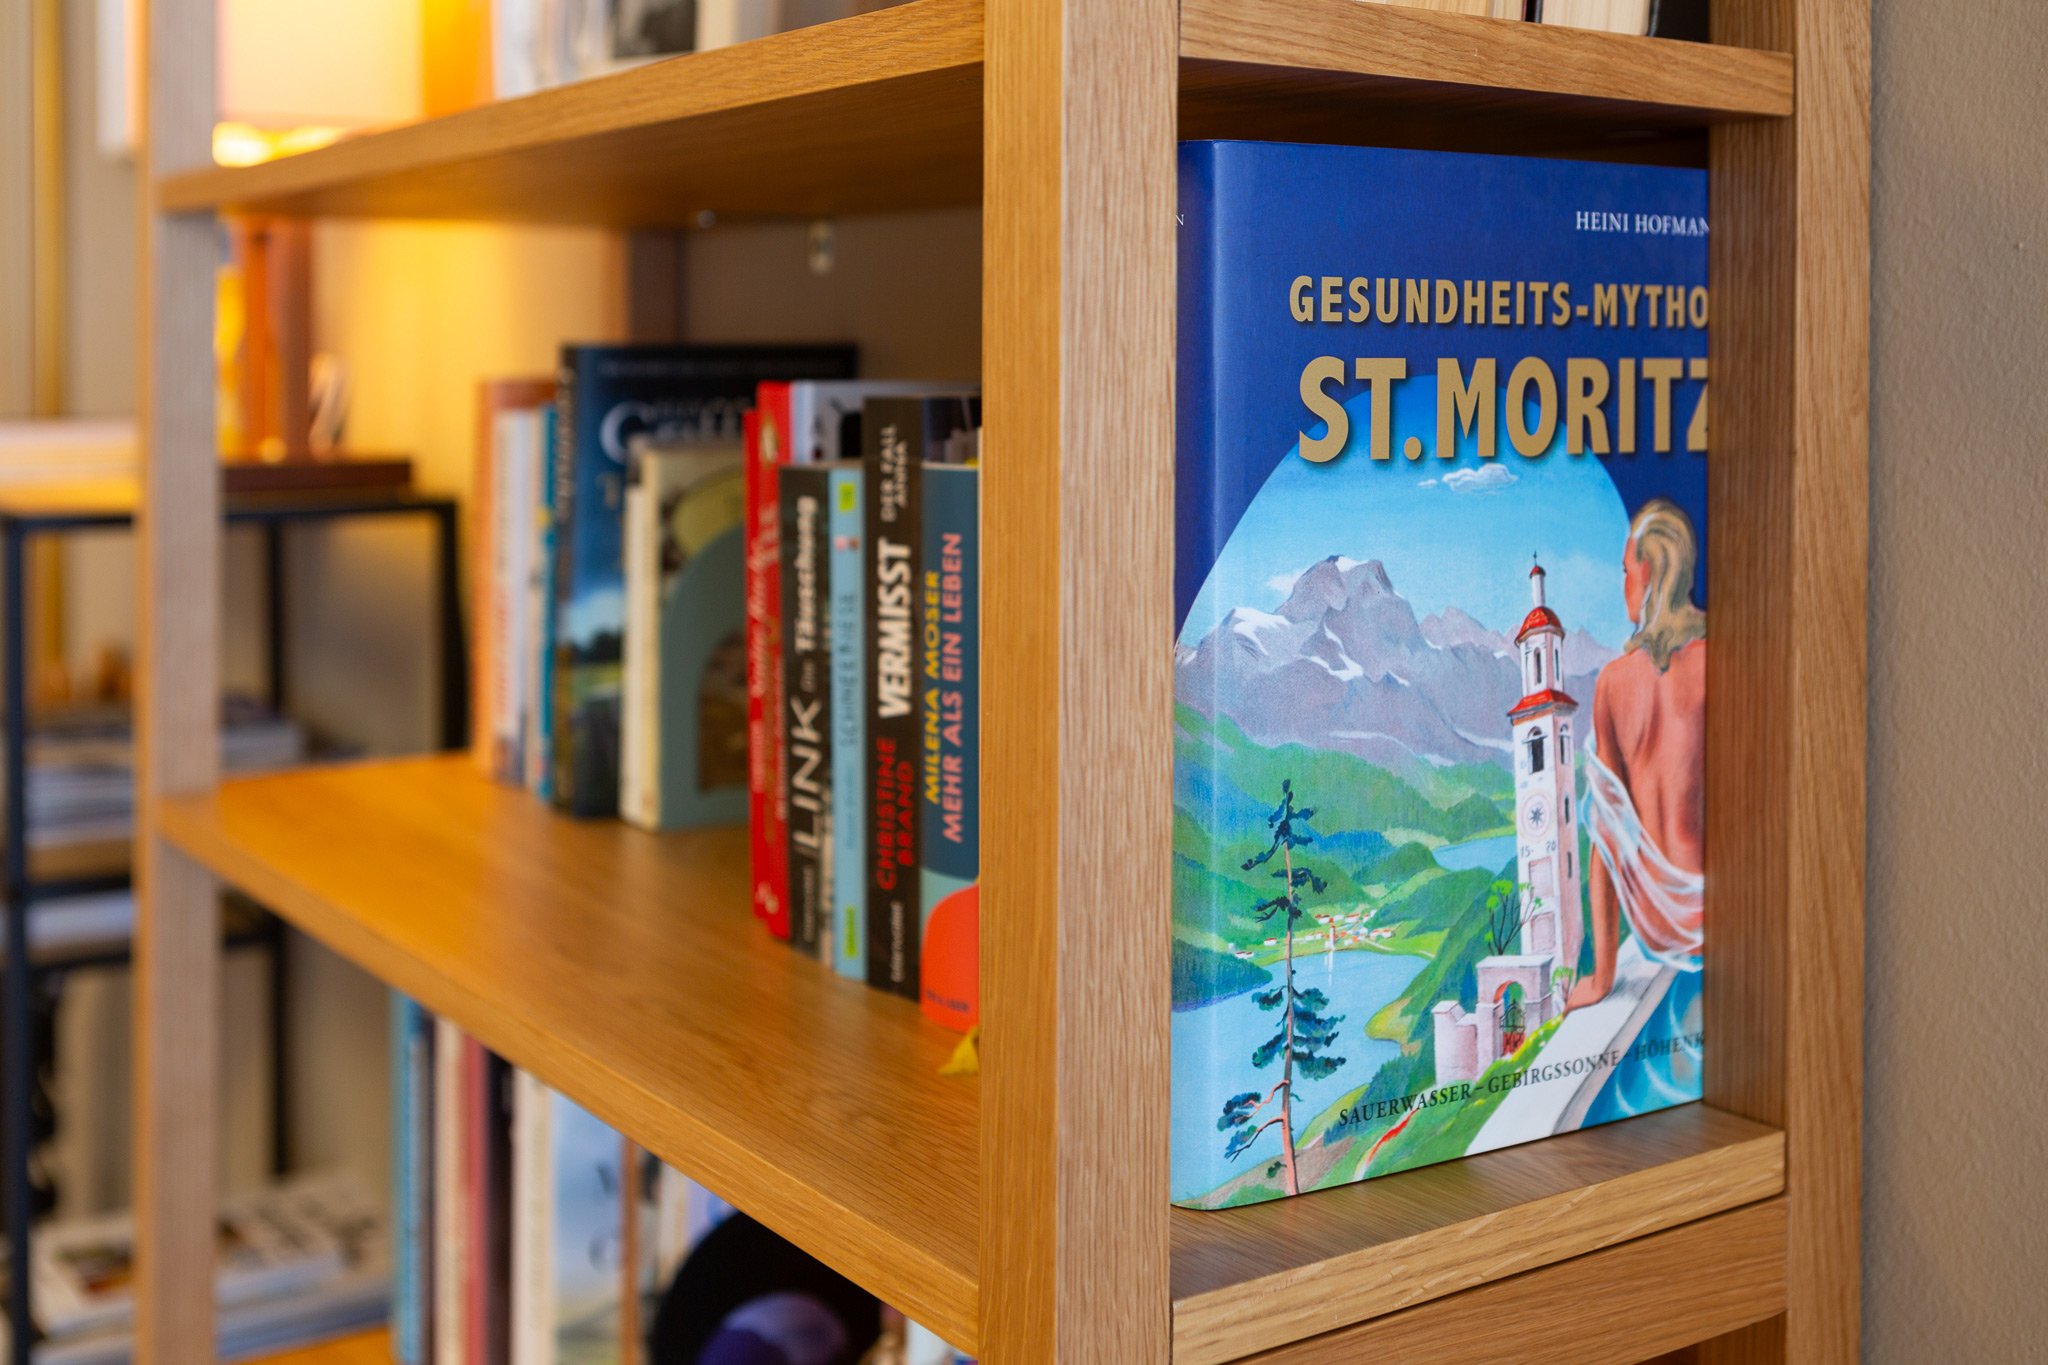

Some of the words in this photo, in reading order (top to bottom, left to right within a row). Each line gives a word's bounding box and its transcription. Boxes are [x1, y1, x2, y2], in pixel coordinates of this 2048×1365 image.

[1576, 210, 1629, 233] HEINI
[1289, 275, 1708, 328] GESUNDHEITS-MYTHO
[794, 496, 818, 656] Täuschung
[942, 532, 963, 623] LEBEN
[878, 537, 912, 718] VERMISST
[925, 571, 941, 680] MOSER
[943, 632, 963, 682] EIN
[925, 688, 941, 804] MILENA
[943, 691, 963, 747] ALS
[790, 696, 822, 850] LINK
[876, 737, 897, 891] CHRISTINE
[896, 761, 915, 867] BRAND
[943, 755, 963, 843] MEHR
[1338, 1082, 1472, 1127] SAUERWASSER
[1487, 1050, 1621, 1095] GEBIRGSSONNE
